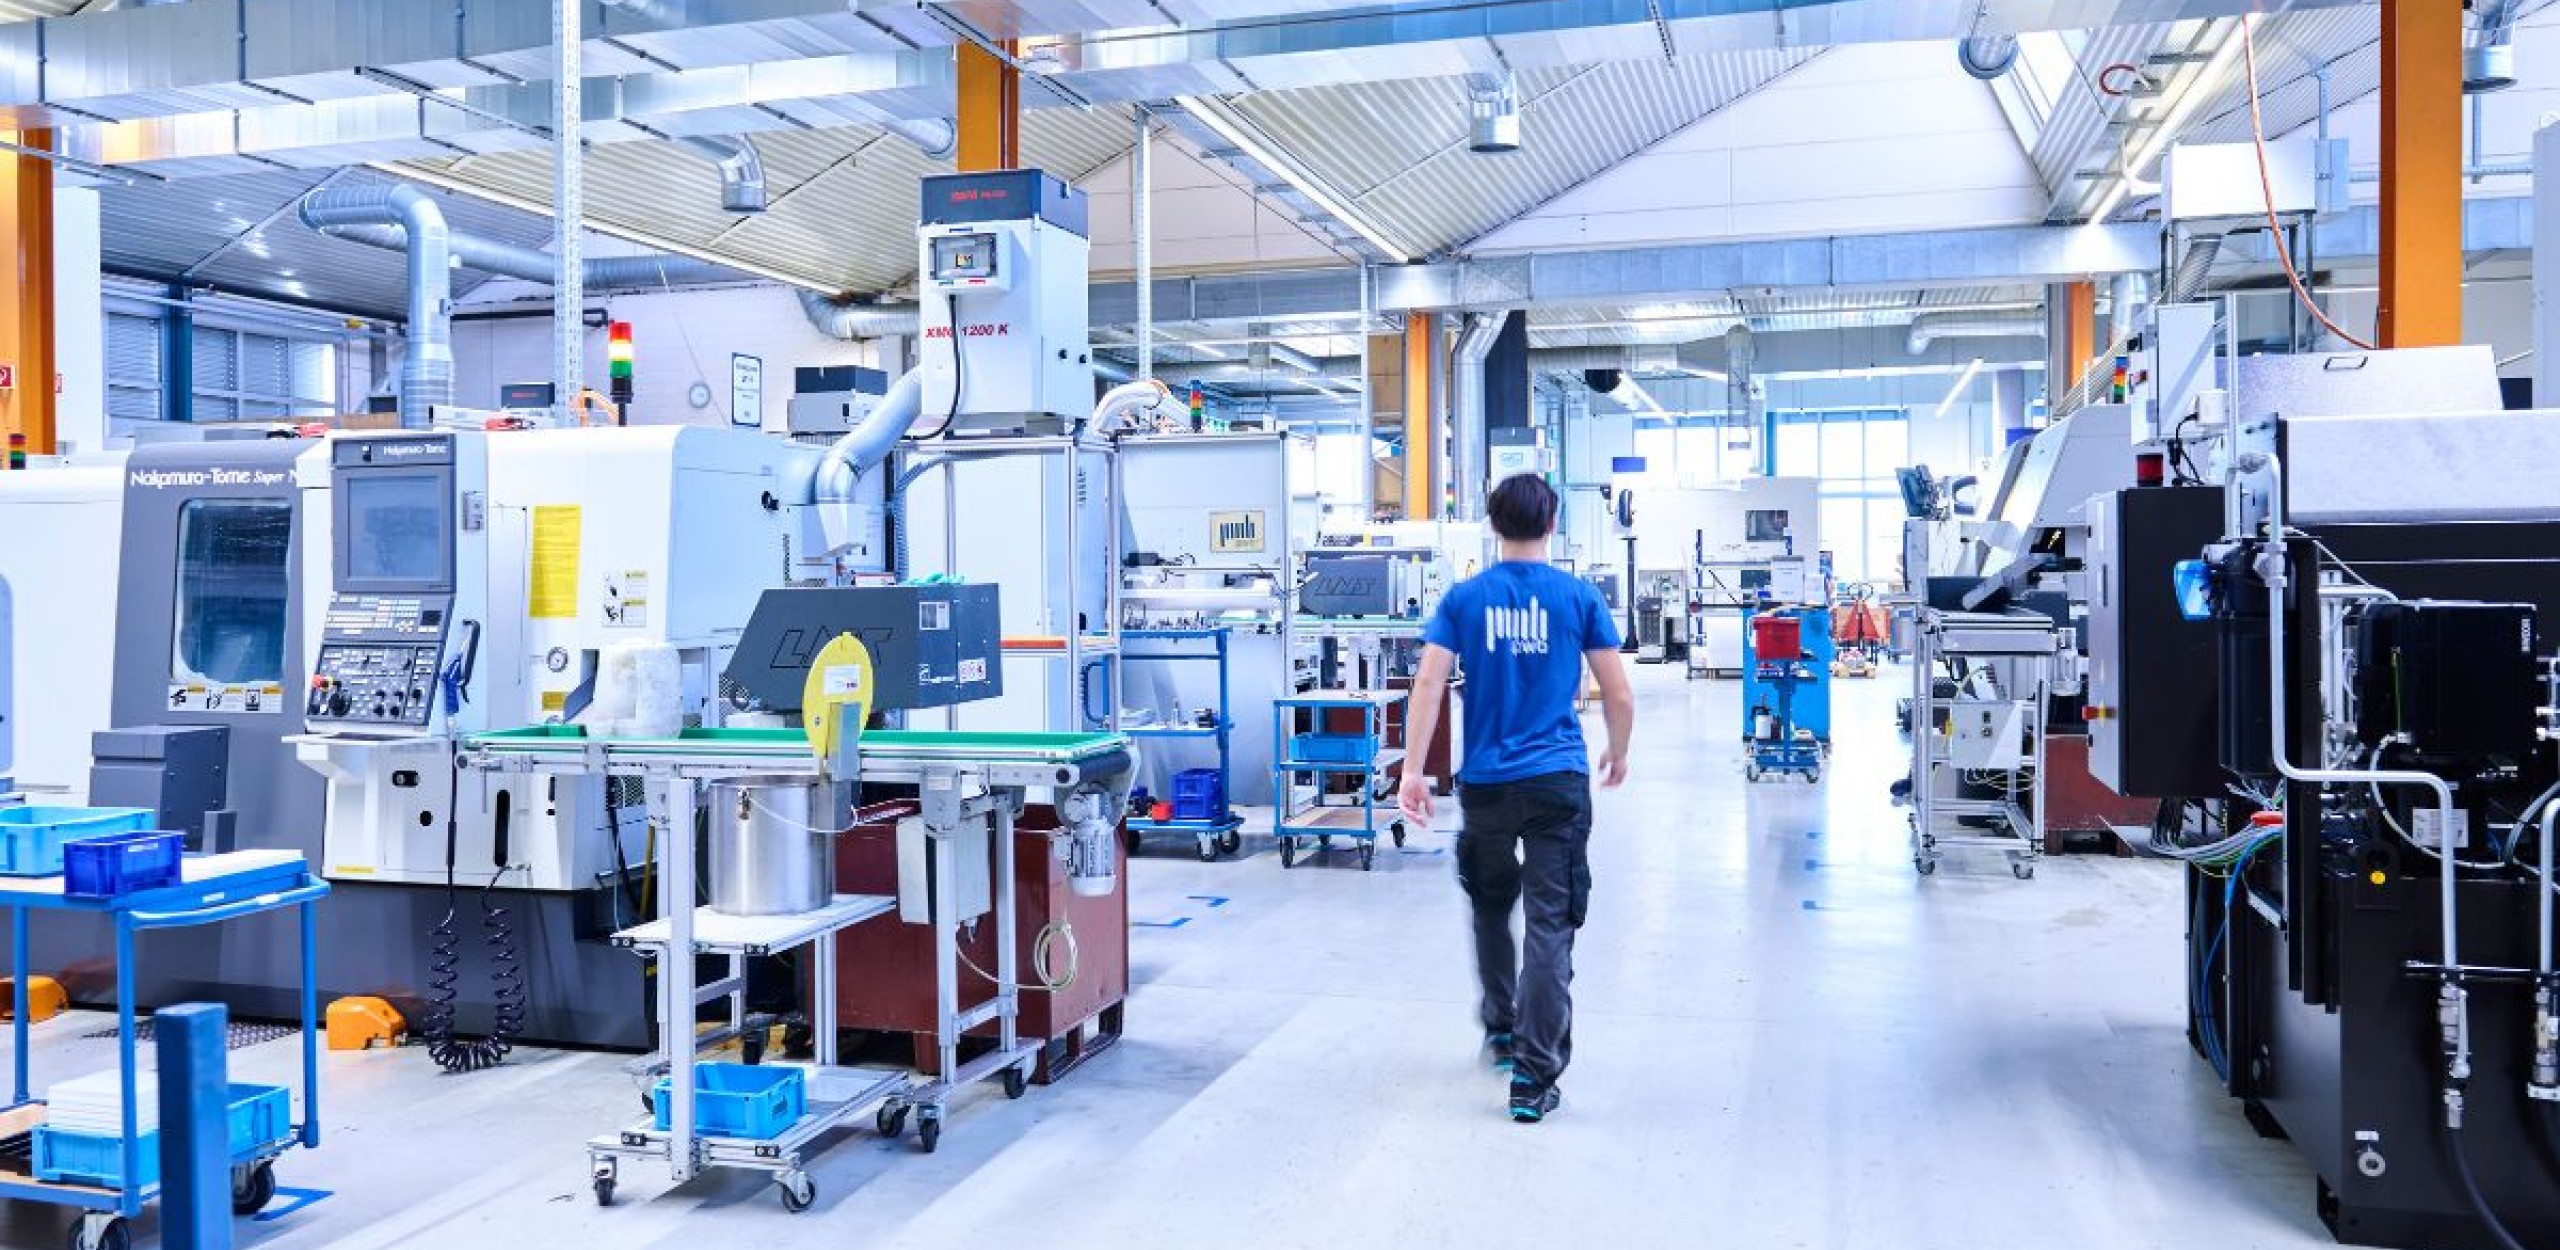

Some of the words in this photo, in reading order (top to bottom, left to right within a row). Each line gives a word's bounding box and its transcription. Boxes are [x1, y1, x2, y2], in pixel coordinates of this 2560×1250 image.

[962, 324, 995, 336] 1200
[998, 323, 1008, 336] K
[130, 467, 250, 490] Nakamura-Tome
[254, 470, 286, 486] Super
